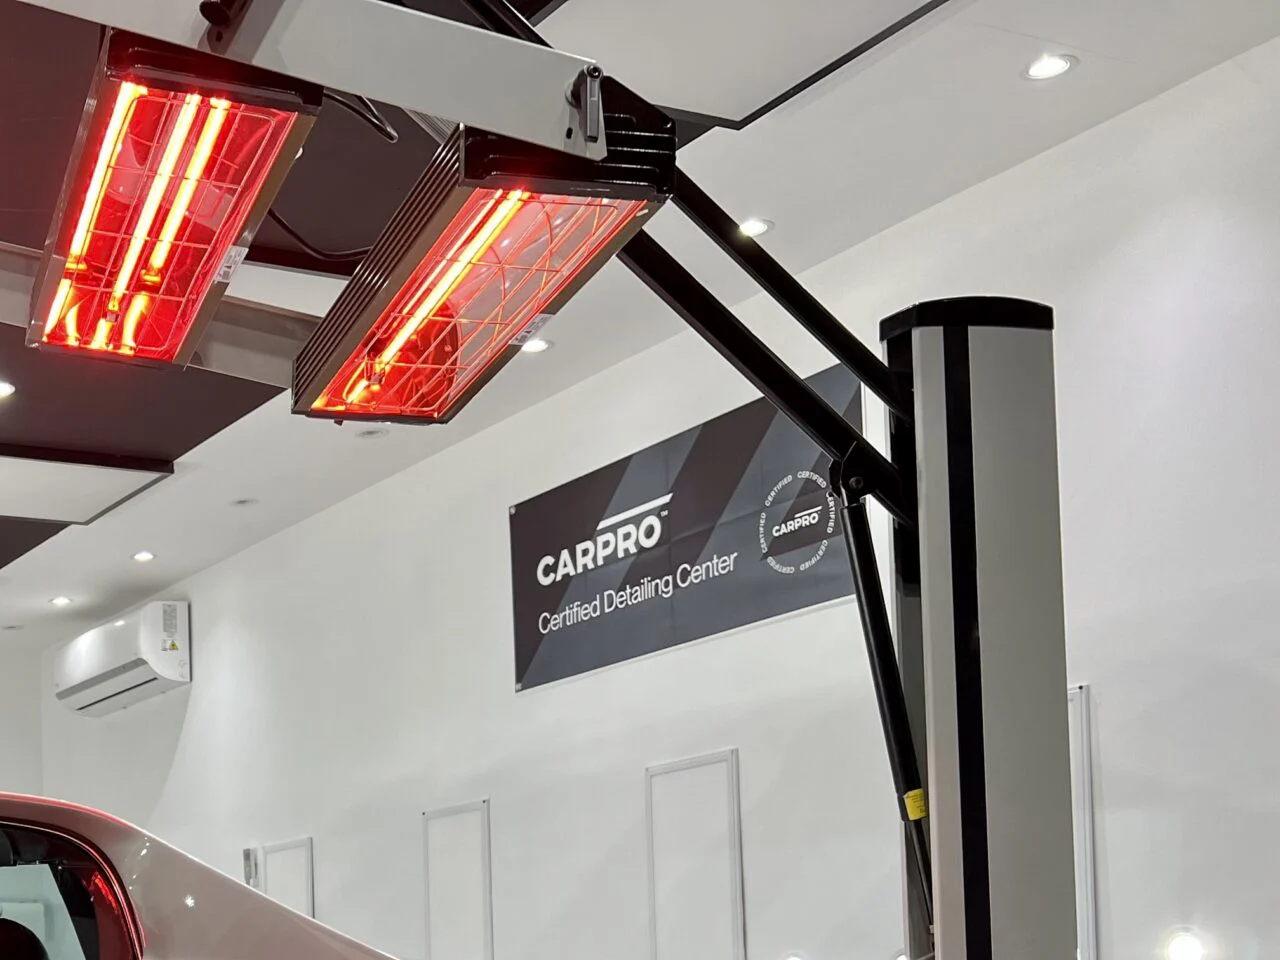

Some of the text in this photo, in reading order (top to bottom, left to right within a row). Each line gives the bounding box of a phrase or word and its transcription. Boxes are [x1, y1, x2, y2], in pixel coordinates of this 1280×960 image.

[764, 474, 793, 507] CERTIFIED
[796, 470, 827, 489] CERTIFIED
[759, 512, 768, 554] CERTIFIED
[772, 512, 819, 537] CARPRO
[799, 539, 829, 571] CERTIFIED
[538, 551, 738, 635] Certified Detailing Center
